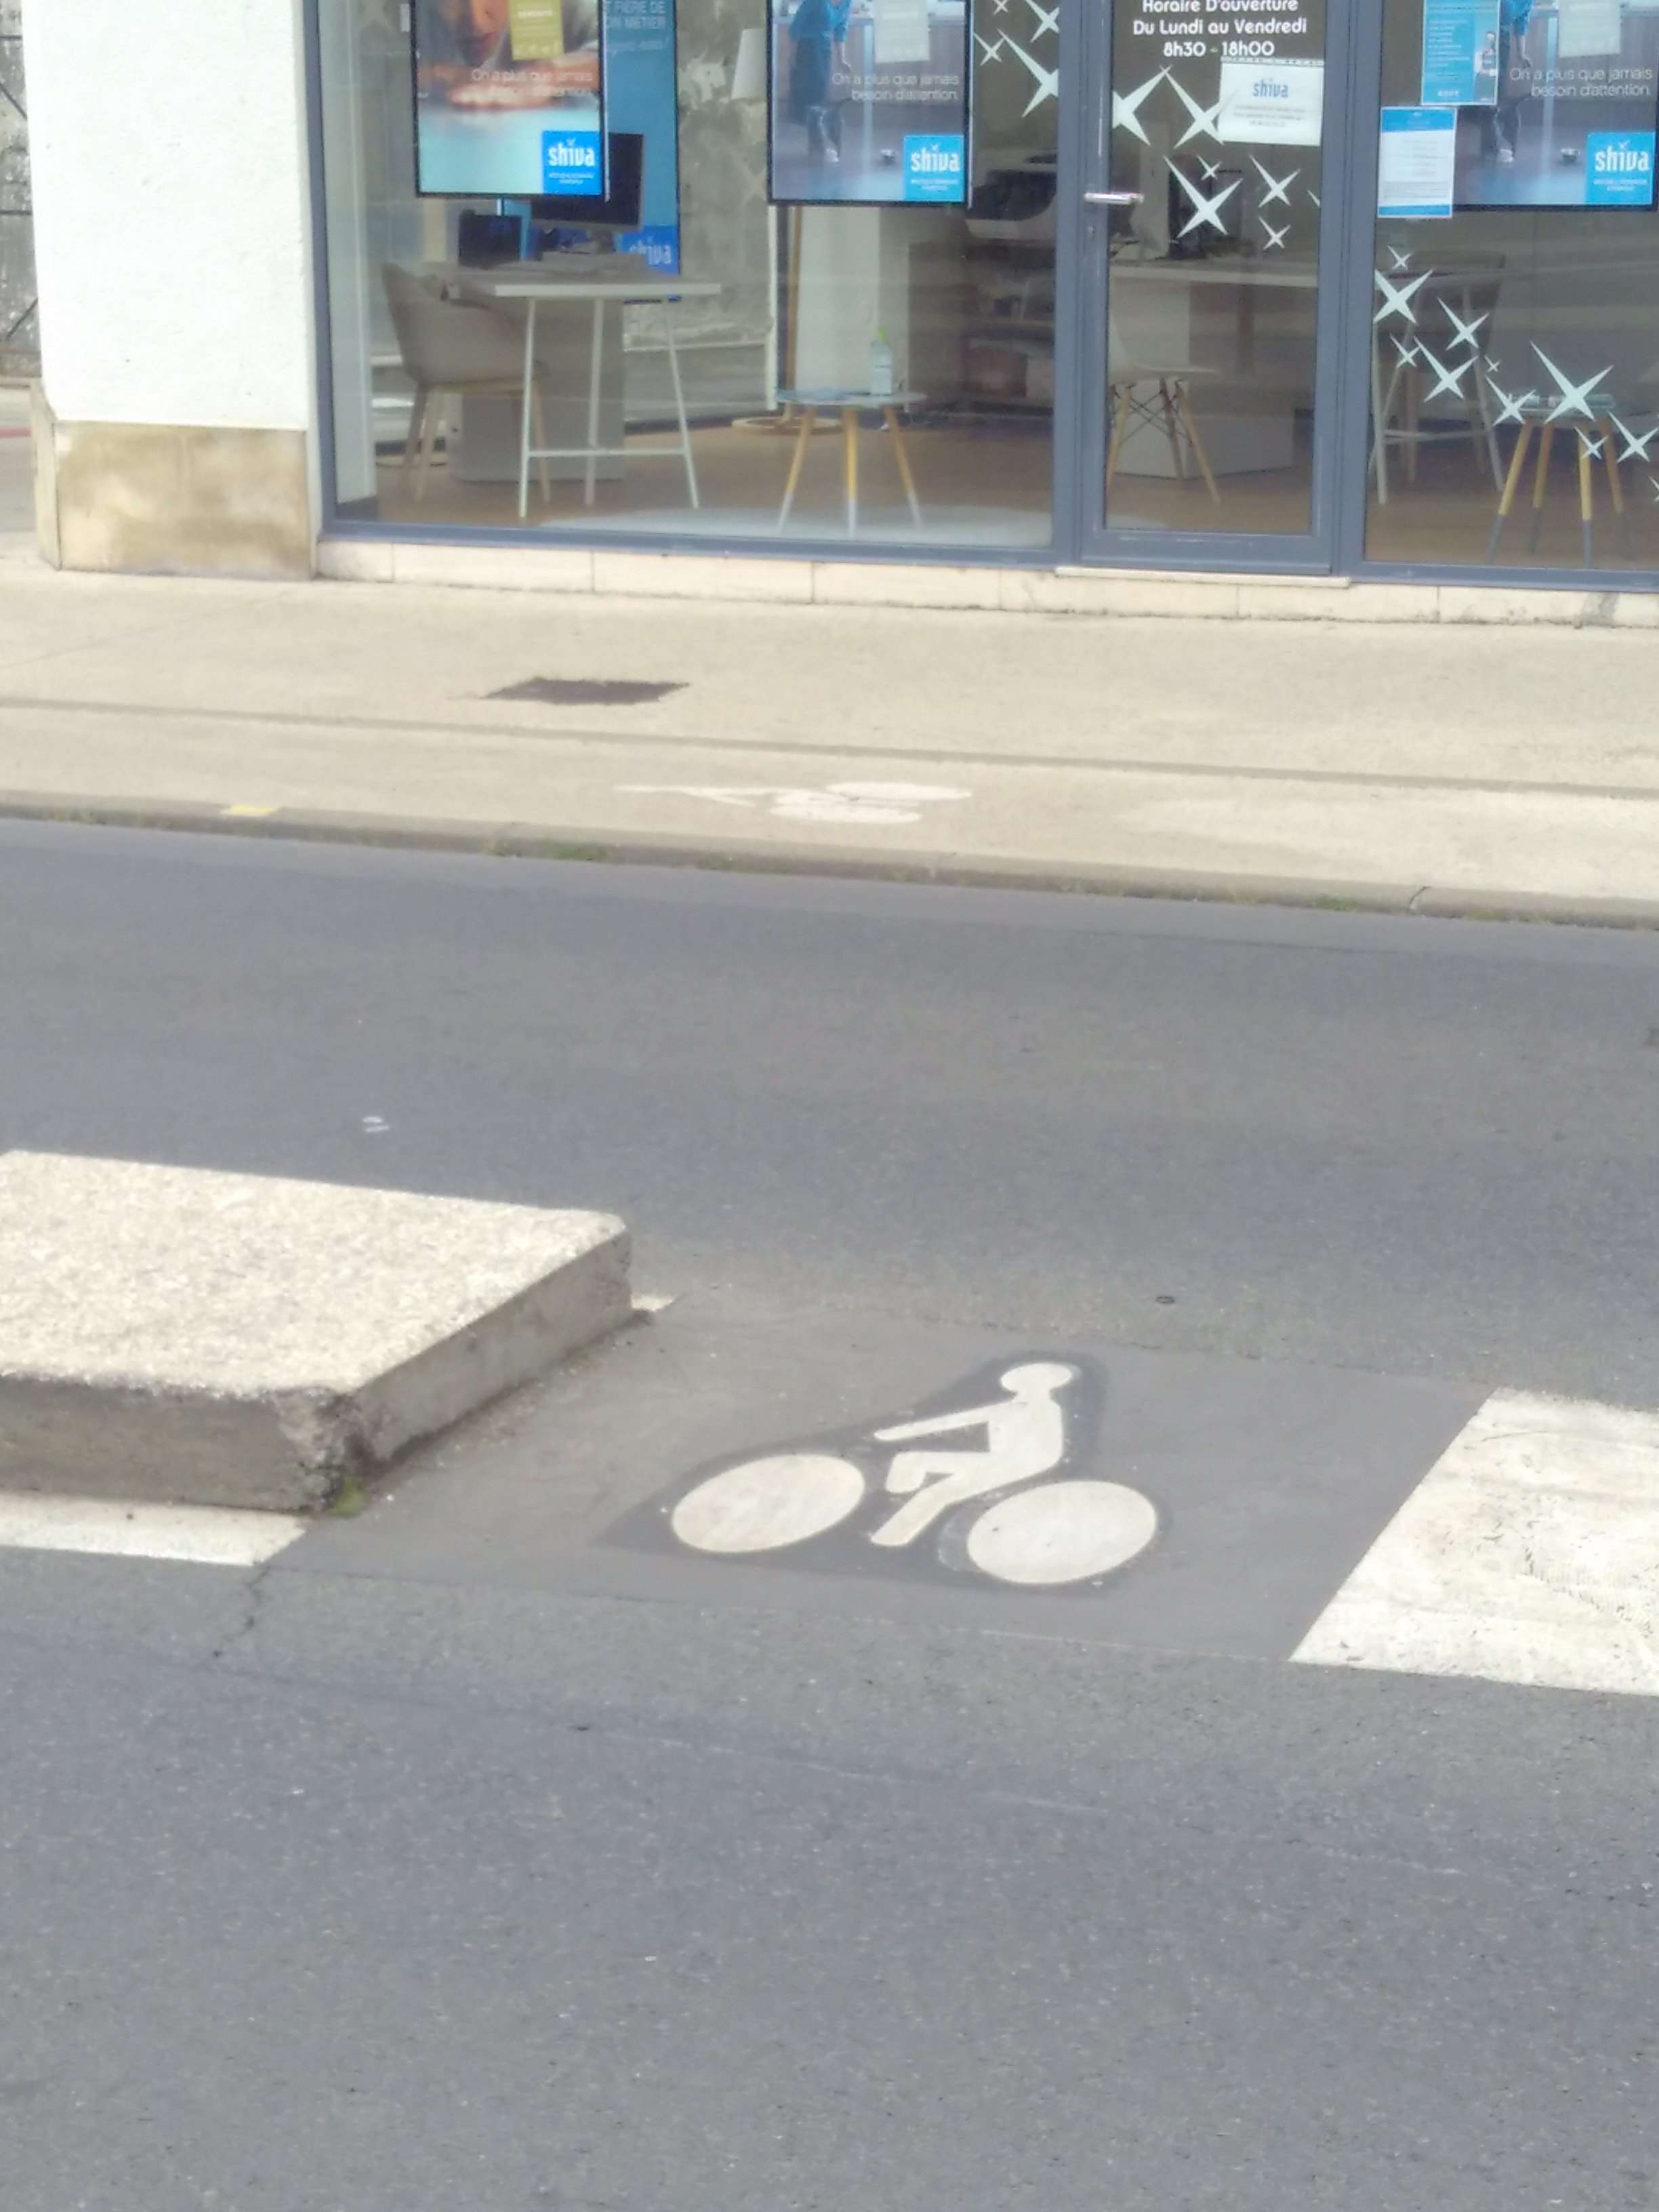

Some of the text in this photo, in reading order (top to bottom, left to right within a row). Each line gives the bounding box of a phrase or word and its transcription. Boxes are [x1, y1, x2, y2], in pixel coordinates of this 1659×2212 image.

[1142, 0, 1298, 13] Horaire D'ouverture
[1132, 18, 1307, 35] Du Lundi au Vendredi
[1163, 41, 1206, 57] 8h30
[1221, 41, 1275, 56] 18h00
[1509, 66, 1653, 83] On a plus que jamais
[1252, 77, 1289, 98] shiva
[1530, 82, 1576, 97] besoin
[548, 138, 596, 167] shiva
[910, 142, 960, 172] shiva
[1594, 140, 1650, 172] shiva
